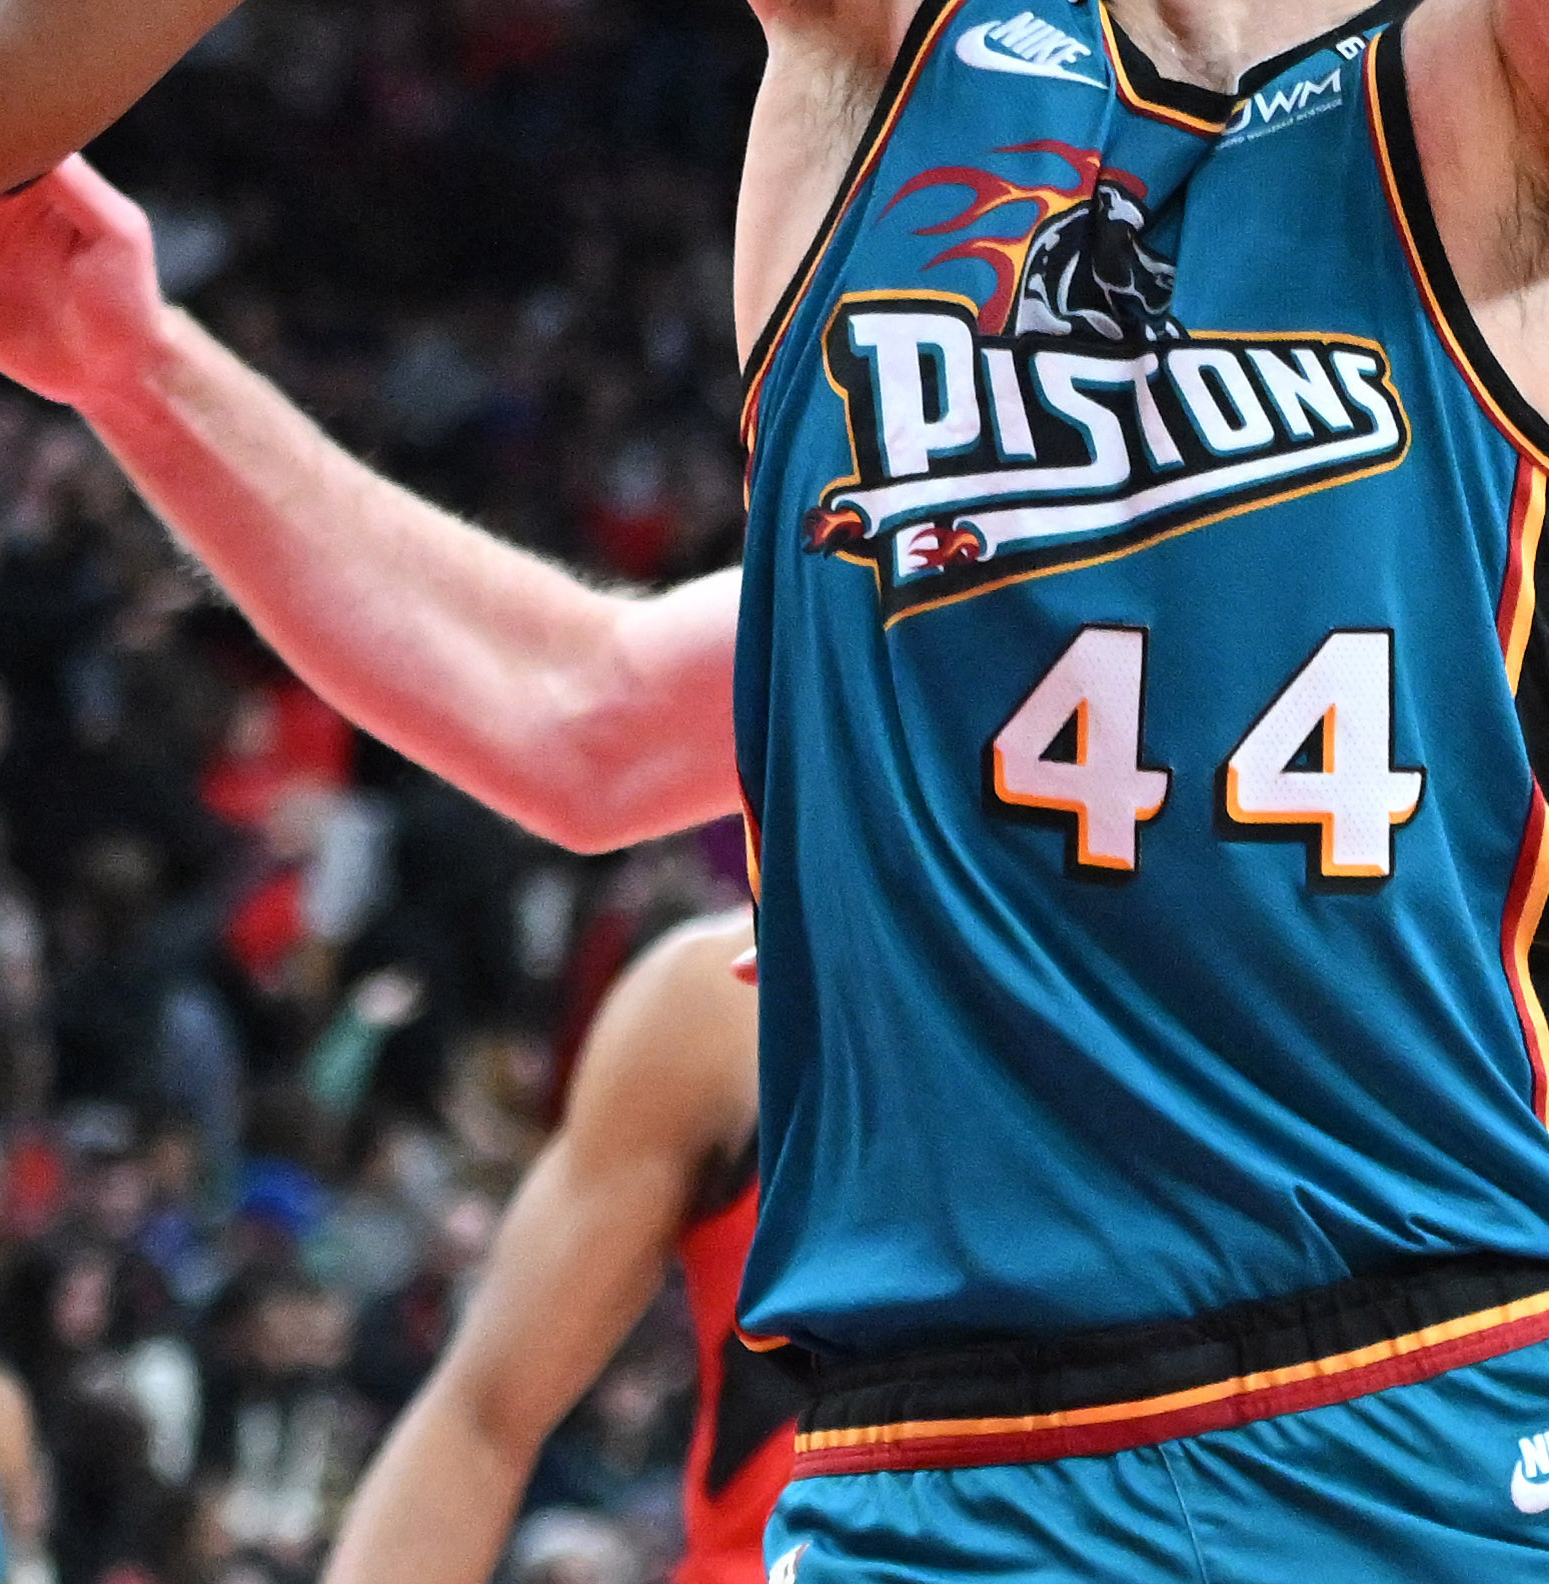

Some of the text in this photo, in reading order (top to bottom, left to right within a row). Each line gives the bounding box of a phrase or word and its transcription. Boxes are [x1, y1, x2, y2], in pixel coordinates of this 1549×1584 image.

[989, 11, 1091, 66] NIKE
[832, 309, 1414, 531] PISTONS
[981, 622, 1424, 894] 44
